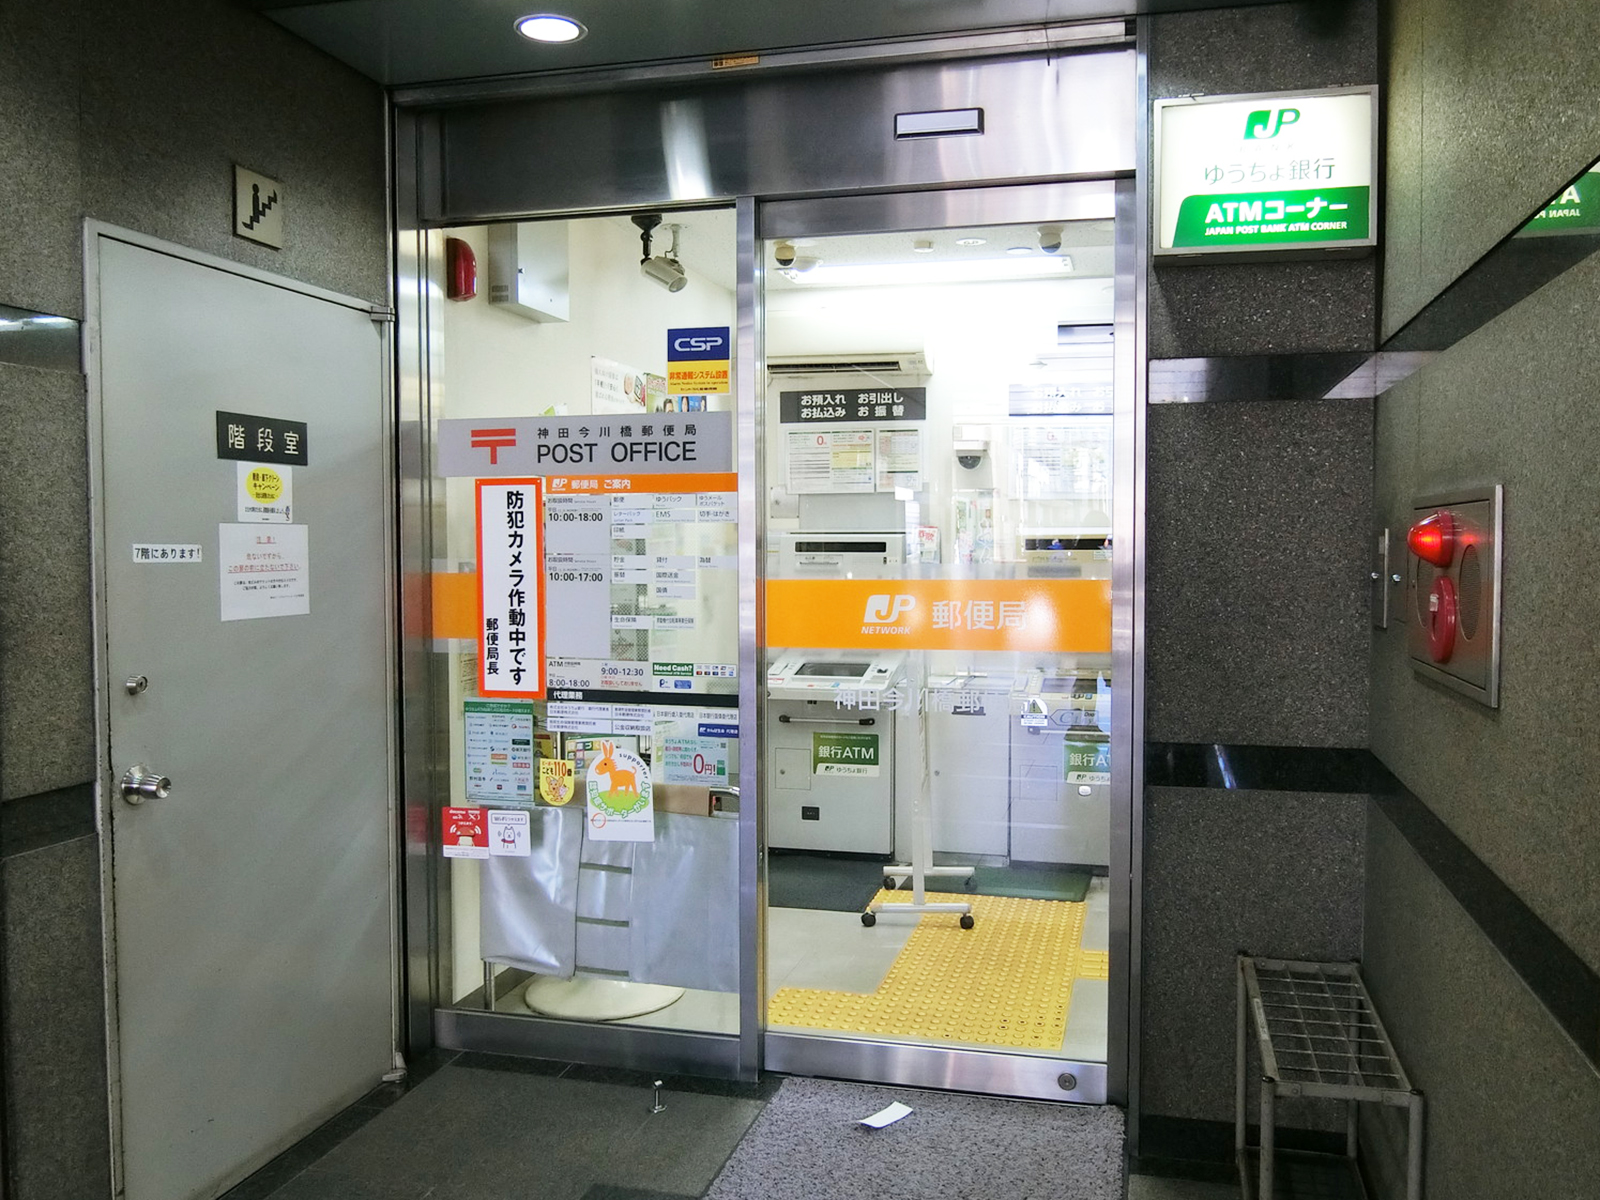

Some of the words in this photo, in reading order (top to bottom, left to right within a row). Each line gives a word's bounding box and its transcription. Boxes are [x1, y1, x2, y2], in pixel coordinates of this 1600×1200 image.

[1204, 157, 1335, 186] ゆうちょ銀行
[1205, 196, 1348, 224] ATMコーナー
[1205, 226, 1233, 236] JAPAN
[1235, 225, 1259, 235] POST
[1261, 224, 1287, 233] BANK
[1288, 223, 1310, 232] ATM
[1311, 221, 1347, 231] CORNER
[674, 336, 723, 352] CSP
[801, 394, 846, 406] お預入れ
[858, 392, 904, 404] お引出し
[801, 407, 846, 419] お払込み
[858, 405, 904, 417] お振替
[537, 424, 698, 439] 神田今川橋郵便局
[228, 424, 299, 455] 階段室
[537, 443, 597, 463] POST
[611, 441, 697, 462] OFFICE
[571, 480, 598, 490] 郵便局
[604, 479, 631, 490] ご案内
[549, 513, 603, 522] 10:00-18:00
[134, 547, 200, 560] 7階にあります!
[549, 572, 603, 582] 10:00-17:00
[507, 490, 527, 686] 防犯カメラ作動中です
[932, 599, 1027, 631] 郵便局
[861, 626, 911, 635] NETWORK
[486, 618, 500, 676] 郵便局長
[600, 667, 644, 676] 9:00-12:30
[672, 664, 693, 672] Cash?
[548, 679, 590, 687] 8:00-18:00
[553, 691, 583, 700] 代理業務
[818, 745, 874, 760] 銀行ATM
[619, 753, 649, 780] supporter
[836, 766, 868, 775] ゆうちょ銀行
